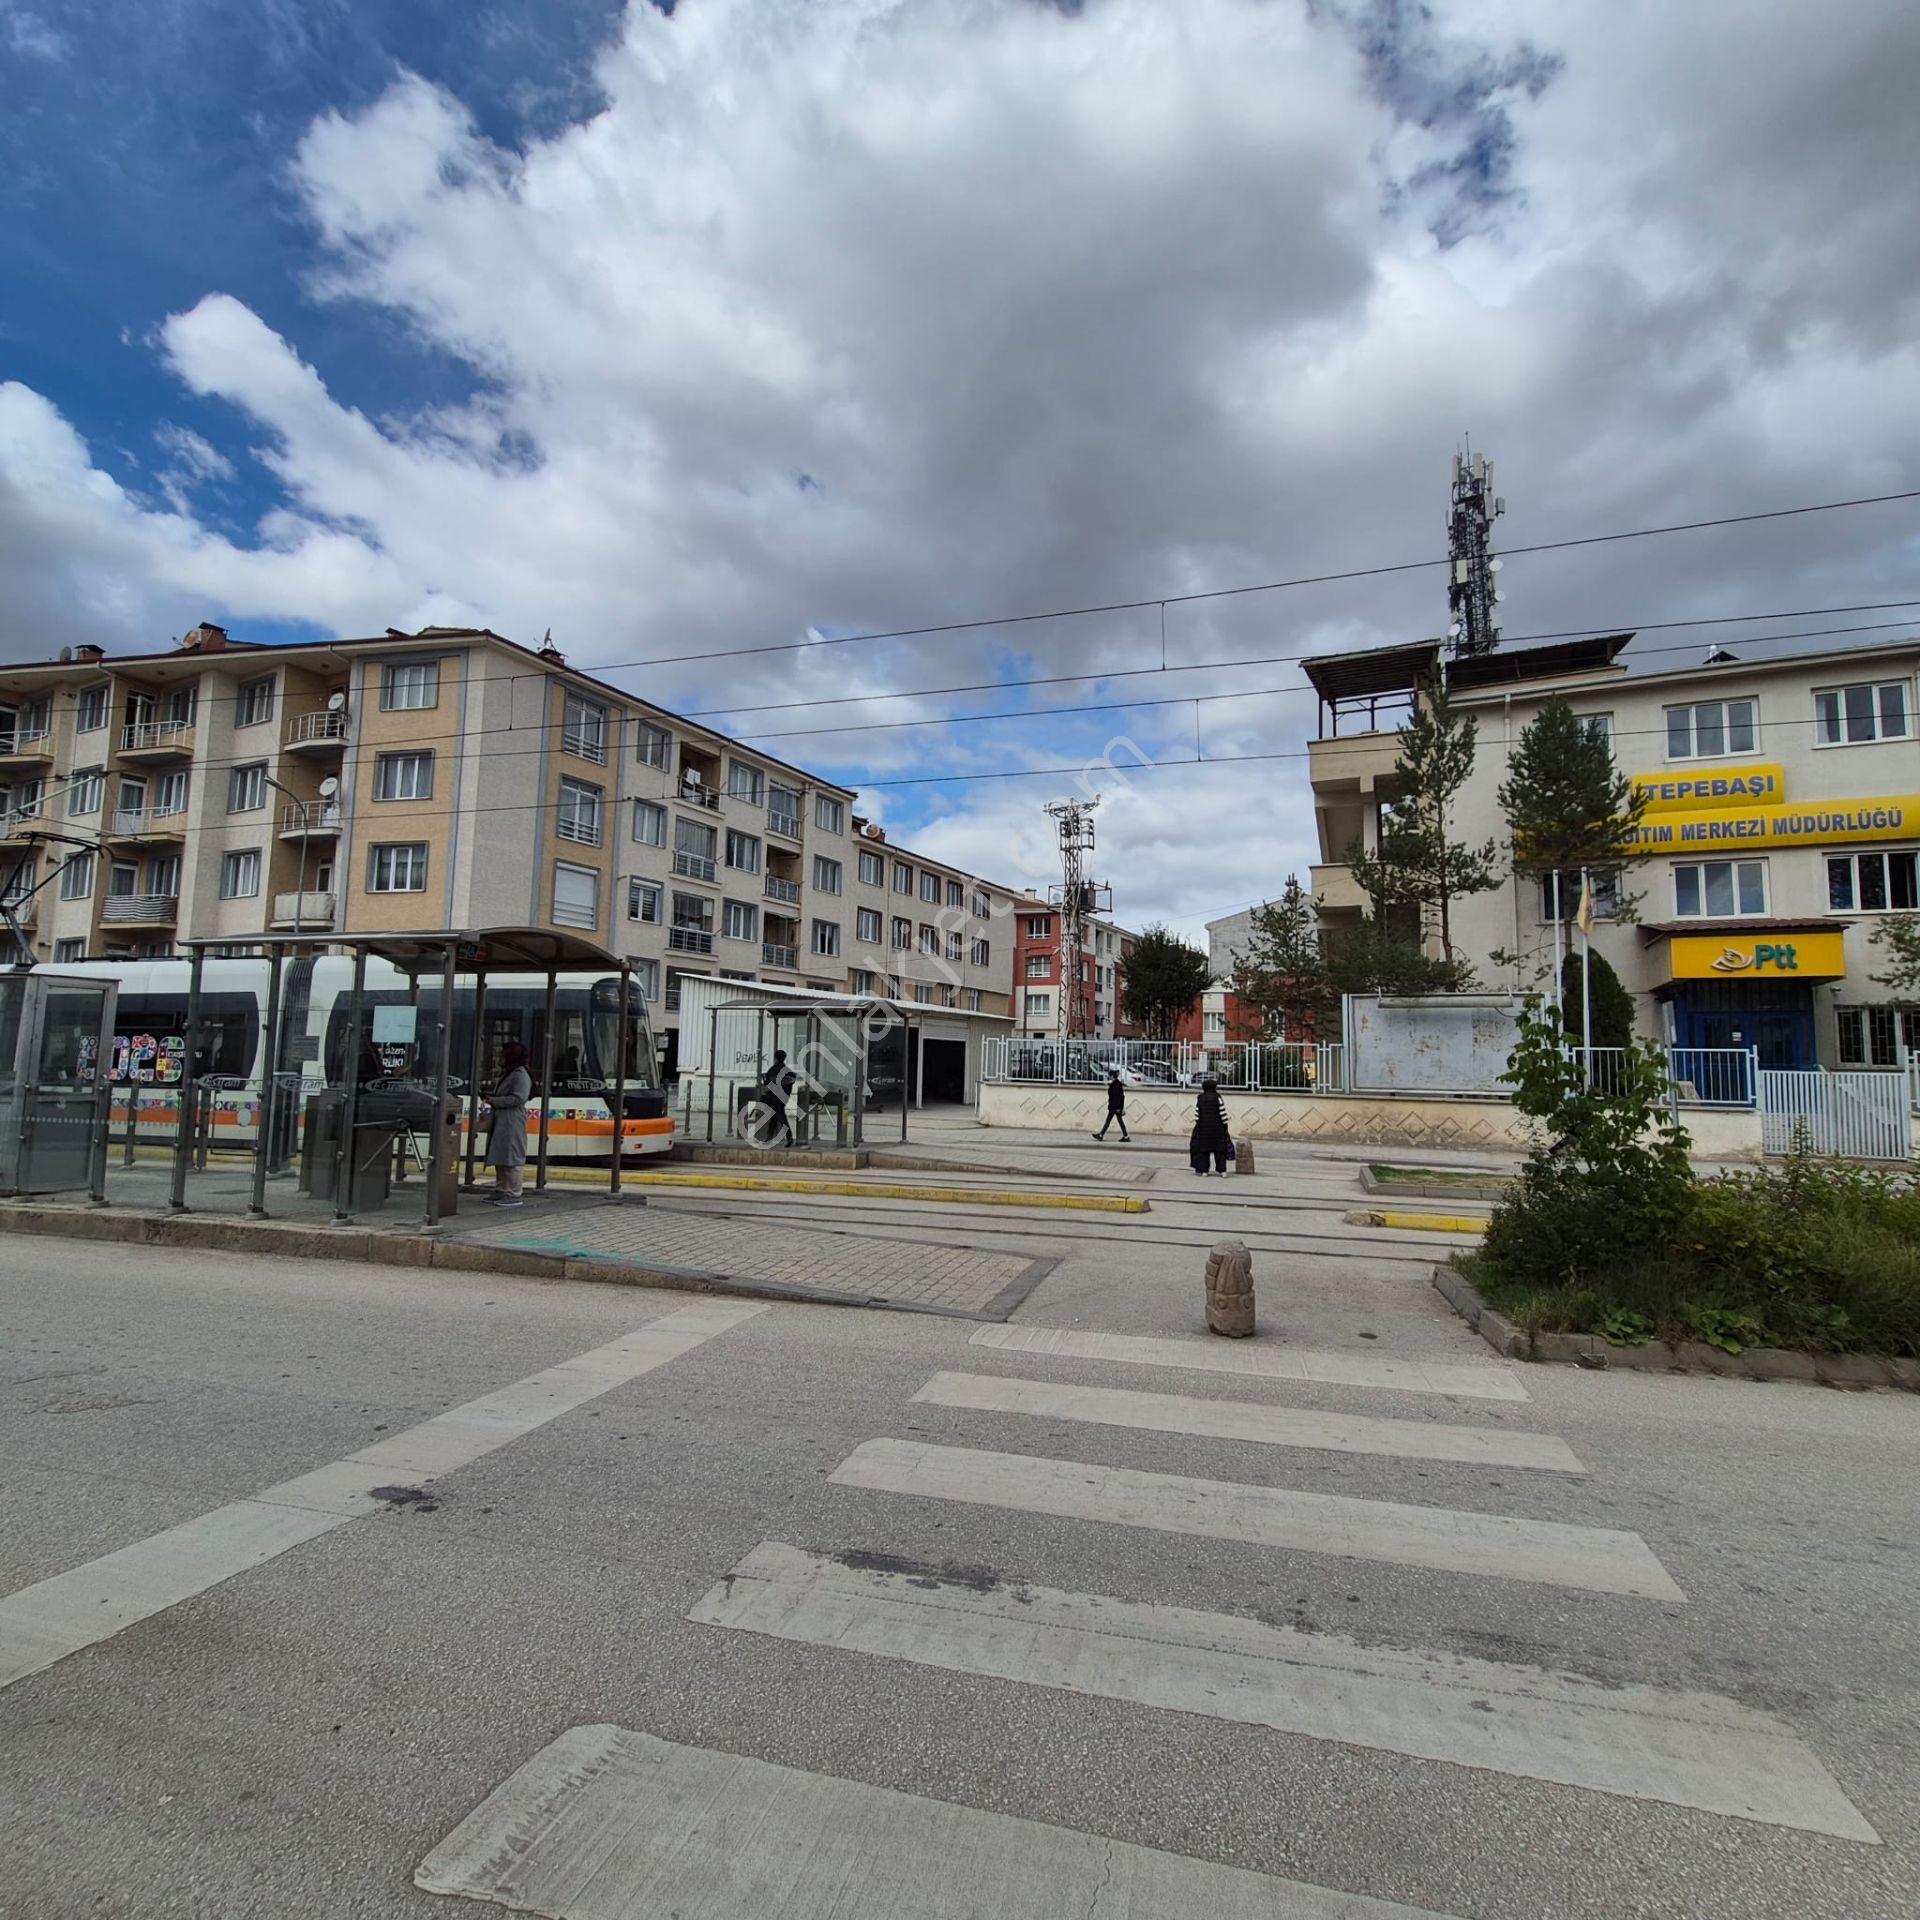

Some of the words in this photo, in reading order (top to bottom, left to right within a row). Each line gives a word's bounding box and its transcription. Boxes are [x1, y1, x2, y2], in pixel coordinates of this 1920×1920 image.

[1642, 775, 1774, 801] TEPEBAŞI
[1681, 815, 1765, 841] MERKEZİ
[1773, 806, 1902, 835] MÜDÜRLÜĞÜ
[1755, 944, 1798, 969] Ptt
